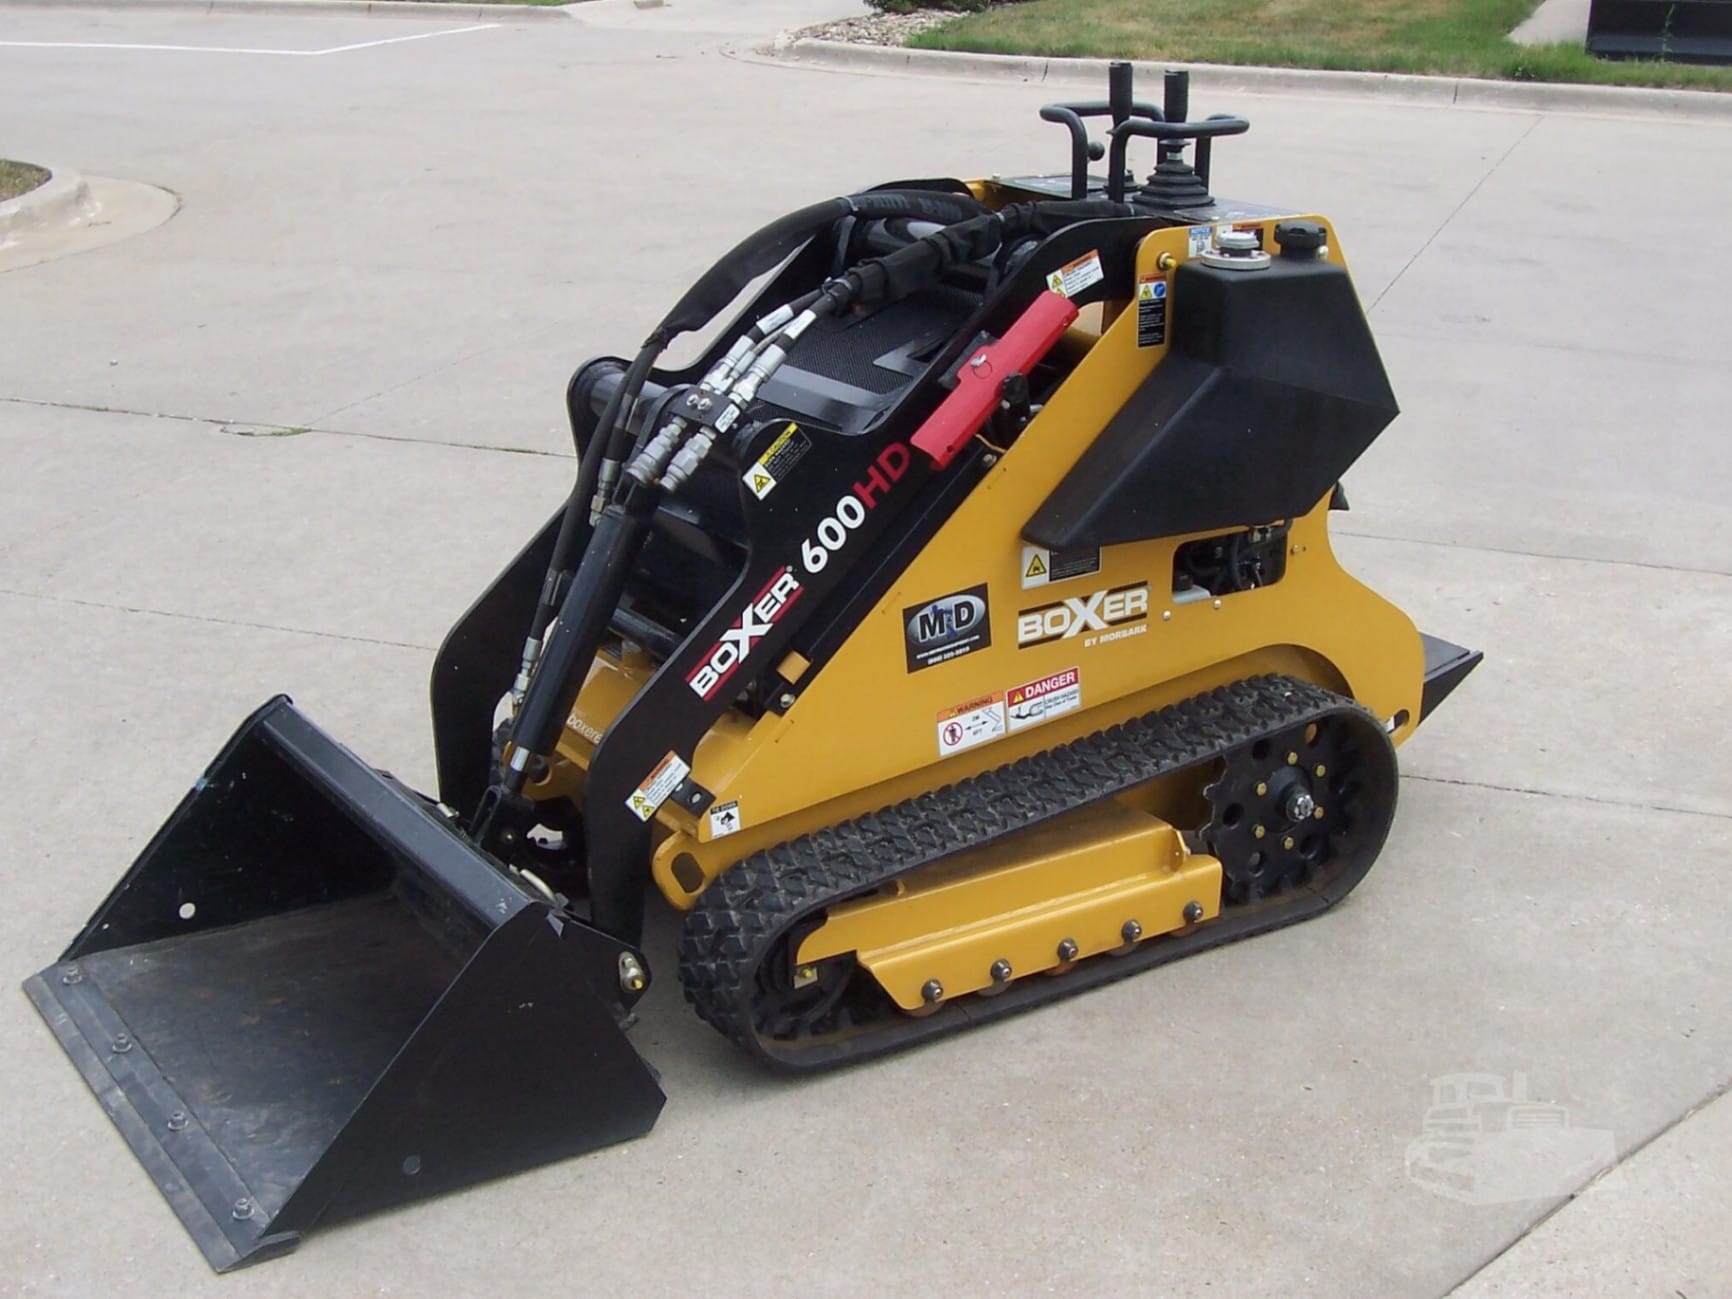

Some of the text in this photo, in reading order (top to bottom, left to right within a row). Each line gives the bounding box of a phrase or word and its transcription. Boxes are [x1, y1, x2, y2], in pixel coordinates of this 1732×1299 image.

[1018, 587, 1148, 643] BOXER
[688, 572, 800, 698] BOXER
[1084, 624, 1148, 648] BY MORBARK
[1025, 671, 1076, 699] DANGER
[957, 696, 993, 714] WARNING
